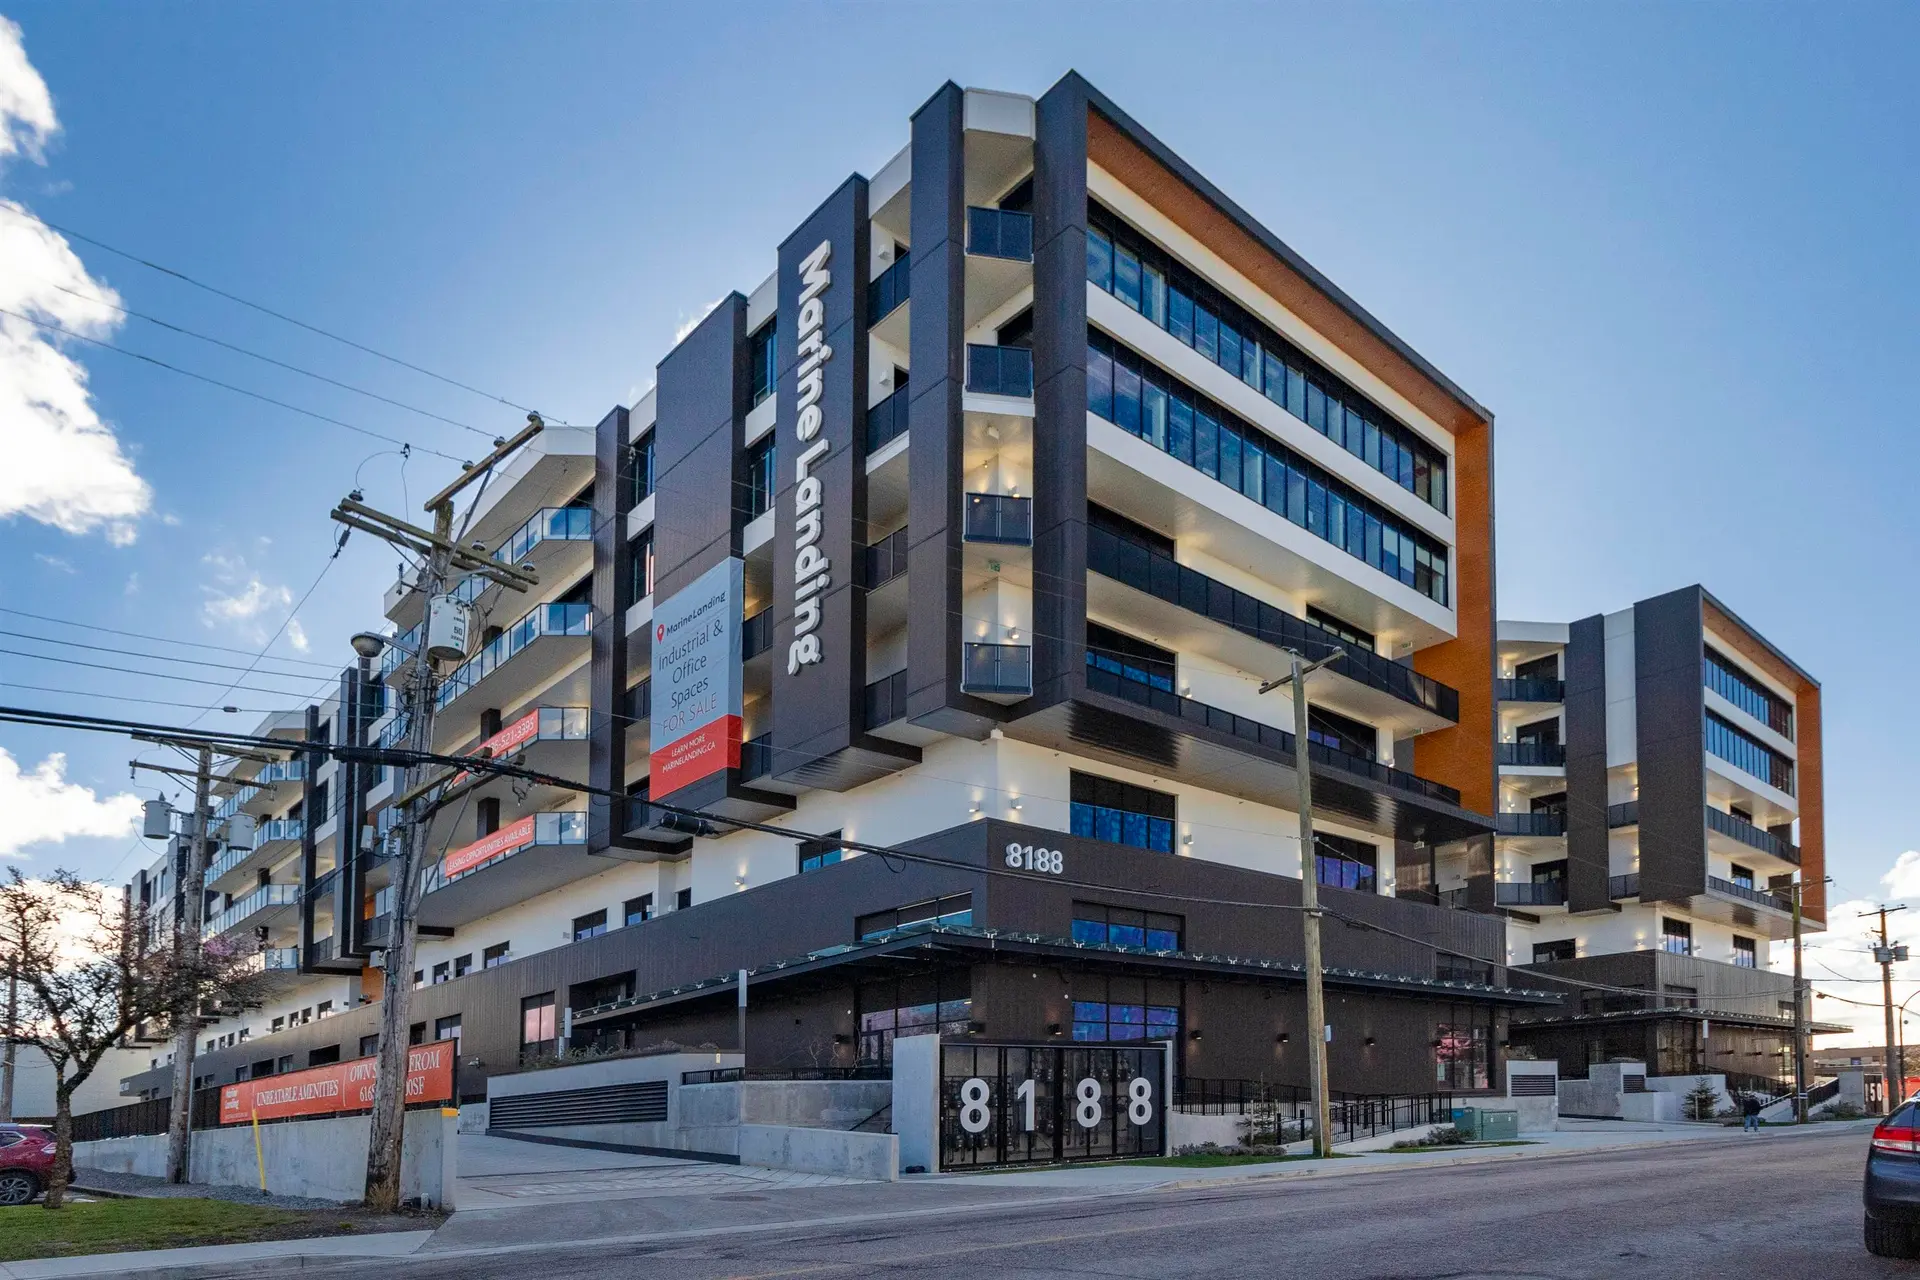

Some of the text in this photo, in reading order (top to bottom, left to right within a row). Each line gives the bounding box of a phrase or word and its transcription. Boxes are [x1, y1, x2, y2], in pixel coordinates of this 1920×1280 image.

[658, 619, 724, 671] Industrial &
[672, 655, 707, 684] Office
[671, 677, 709, 710] Spaces
[662, 692, 717, 736] FOR SALE
[671, 733, 705, 757] LEARN MORE
[447, 824, 532, 871] LEASING OPPORTUNITIES AVAILABLE
[1005, 843, 1064, 875] 8188
[350, 1063, 373, 1082] OWN
[408, 1049, 440, 1073] FROM
[256, 1085, 298, 1106] UNBEATABLE
[298, 1080, 339, 1100] AMENITIES
